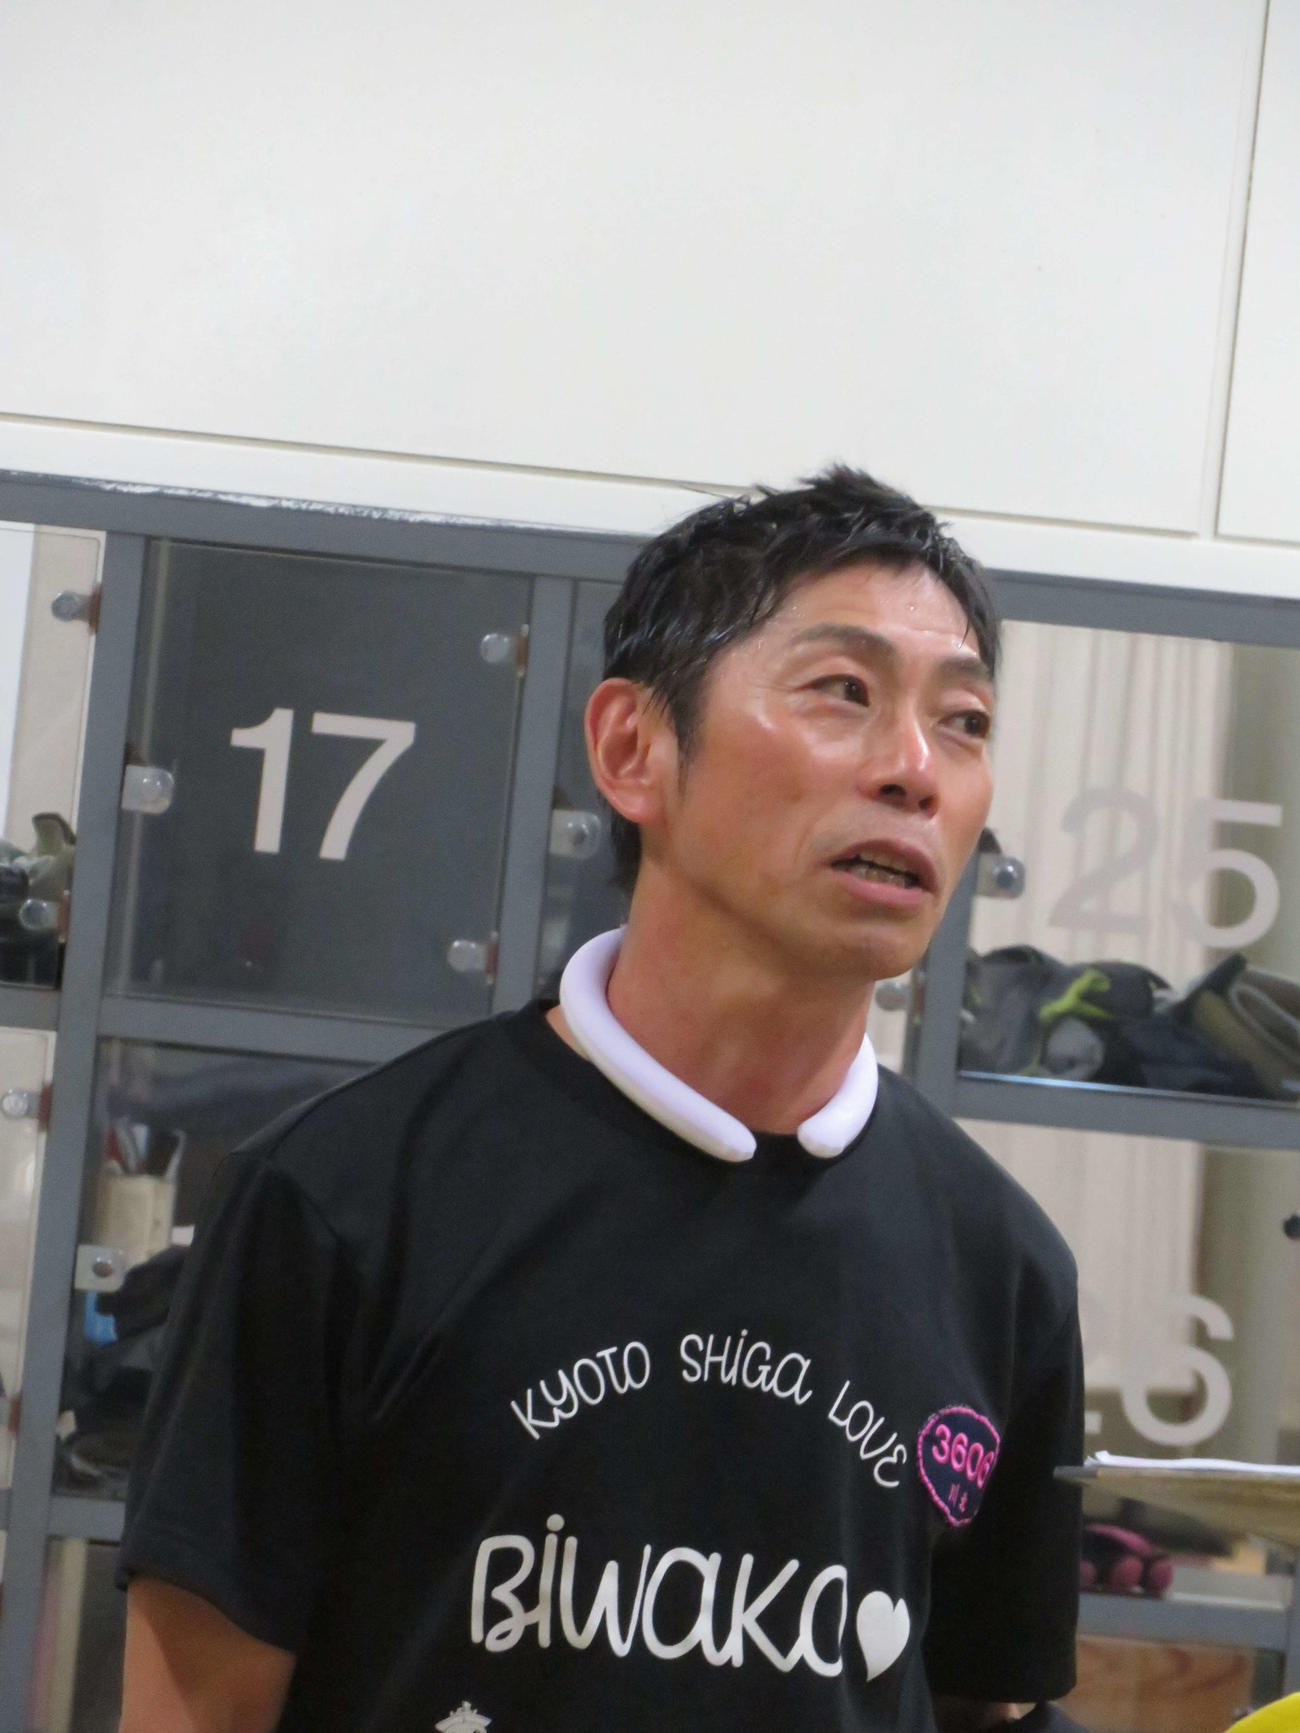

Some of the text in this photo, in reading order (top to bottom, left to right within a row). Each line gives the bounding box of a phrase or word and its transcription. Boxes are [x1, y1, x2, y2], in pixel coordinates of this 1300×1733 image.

[231, 707, 416, 861] 17
[1048, 787, 1284, 950] 25
[828, 1380, 907, 1487] LOVE
[1085, 1294, 1235, 1447] 6
[932, 1424, 995, 1489] 3606
